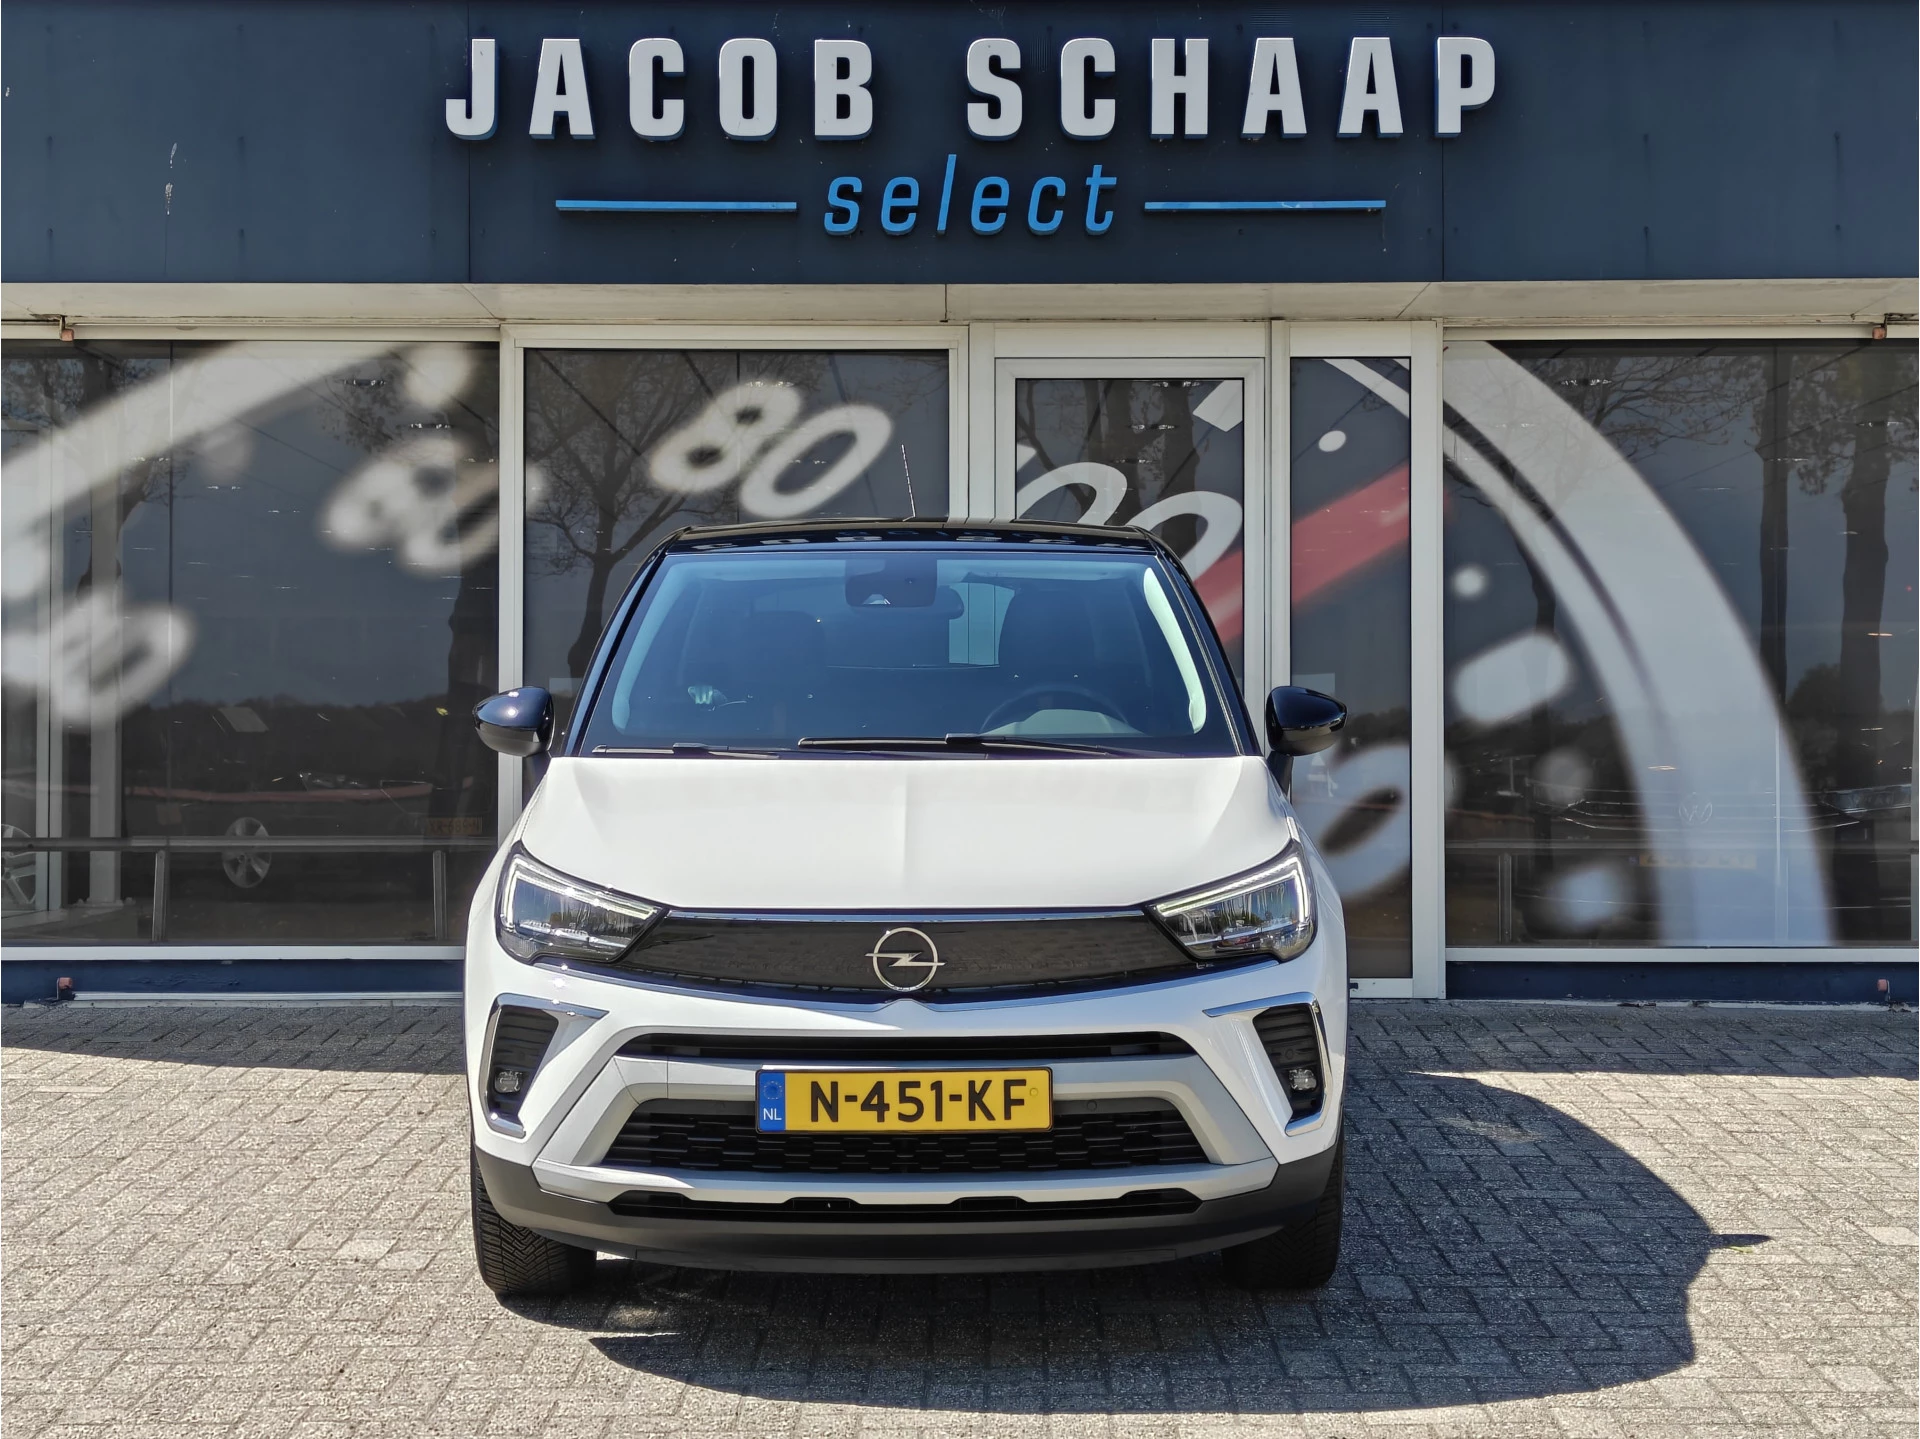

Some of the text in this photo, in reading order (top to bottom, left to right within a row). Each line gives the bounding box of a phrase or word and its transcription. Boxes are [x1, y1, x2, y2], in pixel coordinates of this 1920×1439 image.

[445, 36, 1496, 141] JACOB SCHAAP
[824, 153, 1118, 236] select
[650, 379, 892, 518] 80
[763, 1107, 782, 1121] NL
[810, 1078, 1027, 1123] N-451-KF
